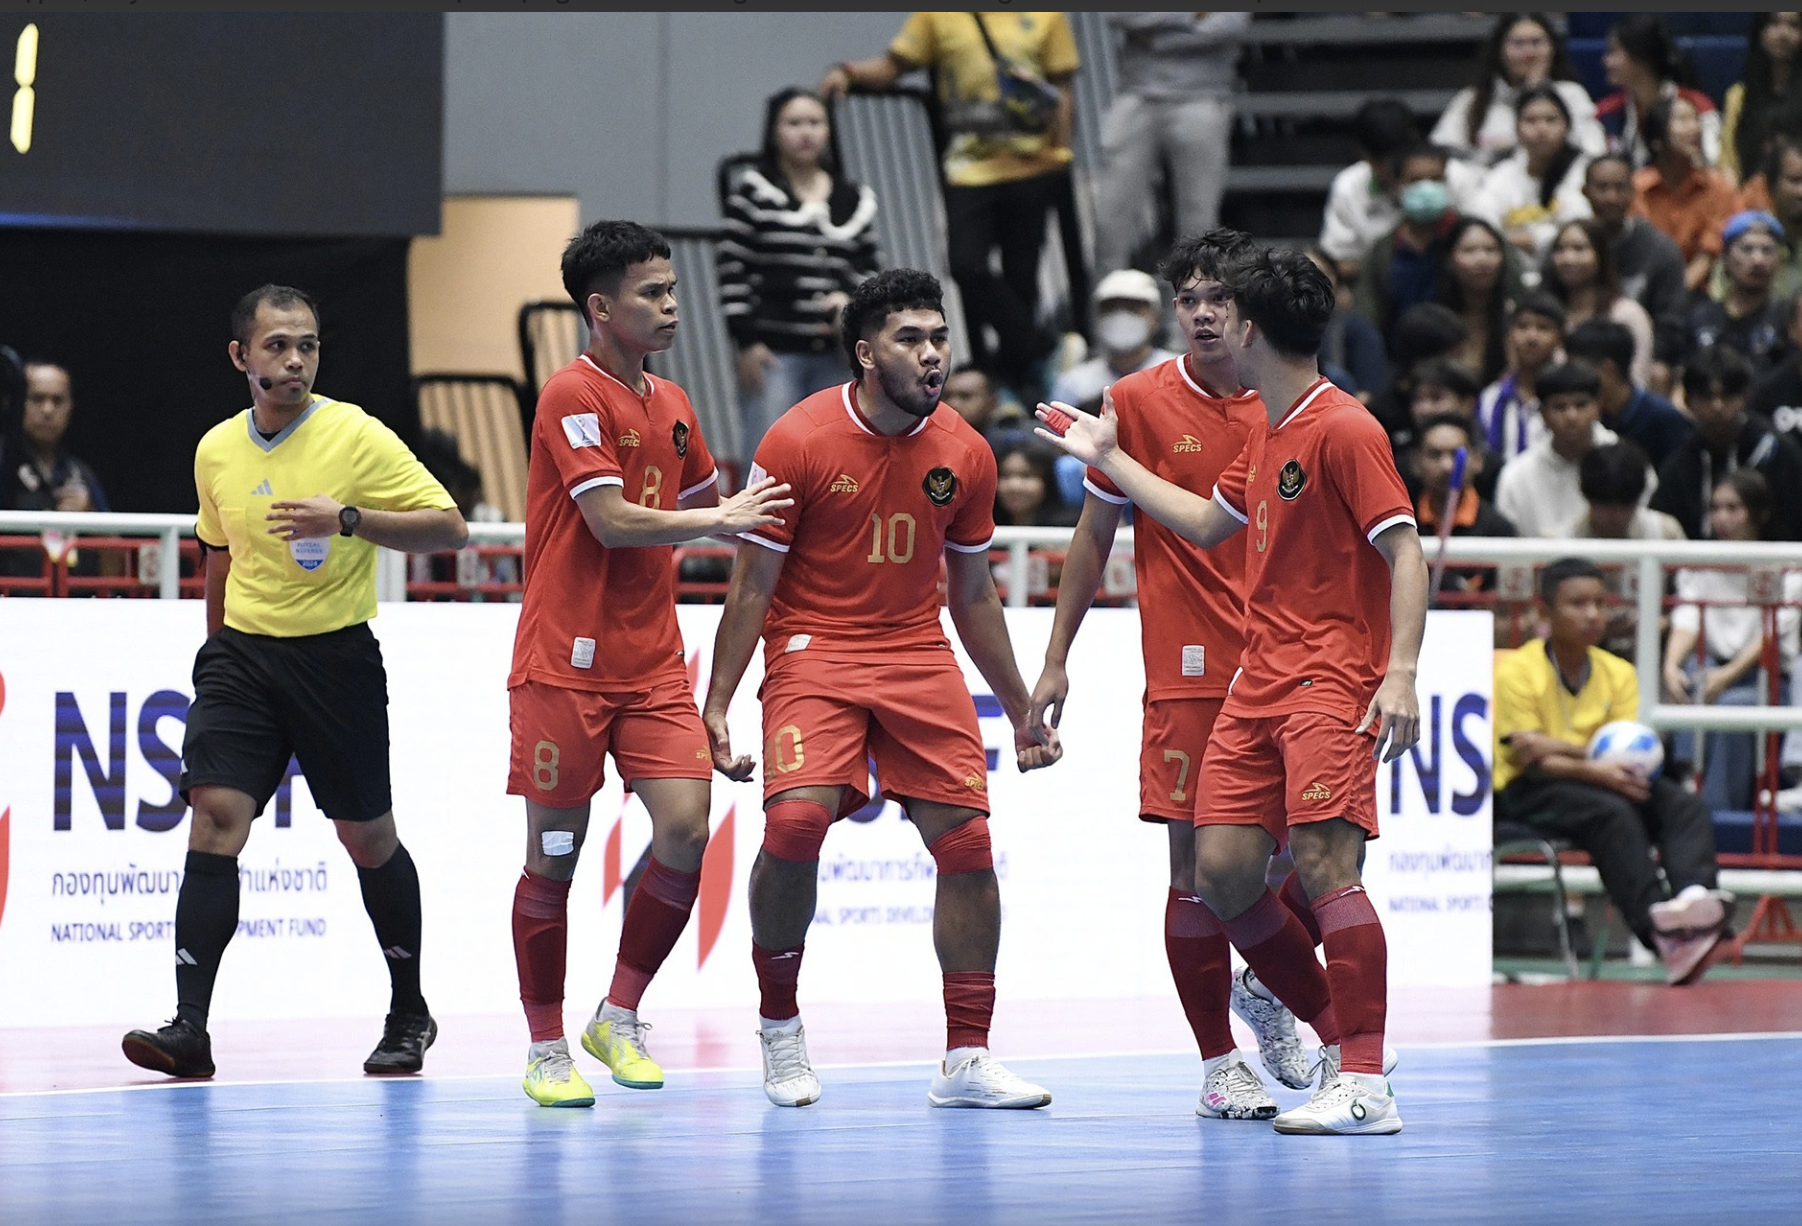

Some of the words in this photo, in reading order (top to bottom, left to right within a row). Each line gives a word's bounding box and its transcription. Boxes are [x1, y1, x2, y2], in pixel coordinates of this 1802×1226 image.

[10, 22, 39, 154] 1
[1173, 443, 1201, 453] SPECS
[639, 465, 662, 510] 8
[830, 484, 858, 493] SPECS
[867, 512, 916, 564] 10
[1256, 500, 1268, 553] 9
[533, 740, 560, 791] 8
[1164, 750, 1190, 801] 7
[1302, 791, 1331, 801] SPECS
[50, 921, 123, 942] NATIONAL
[128, 919, 177, 941] SPORT
[289, 918, 327, 936] FUND
